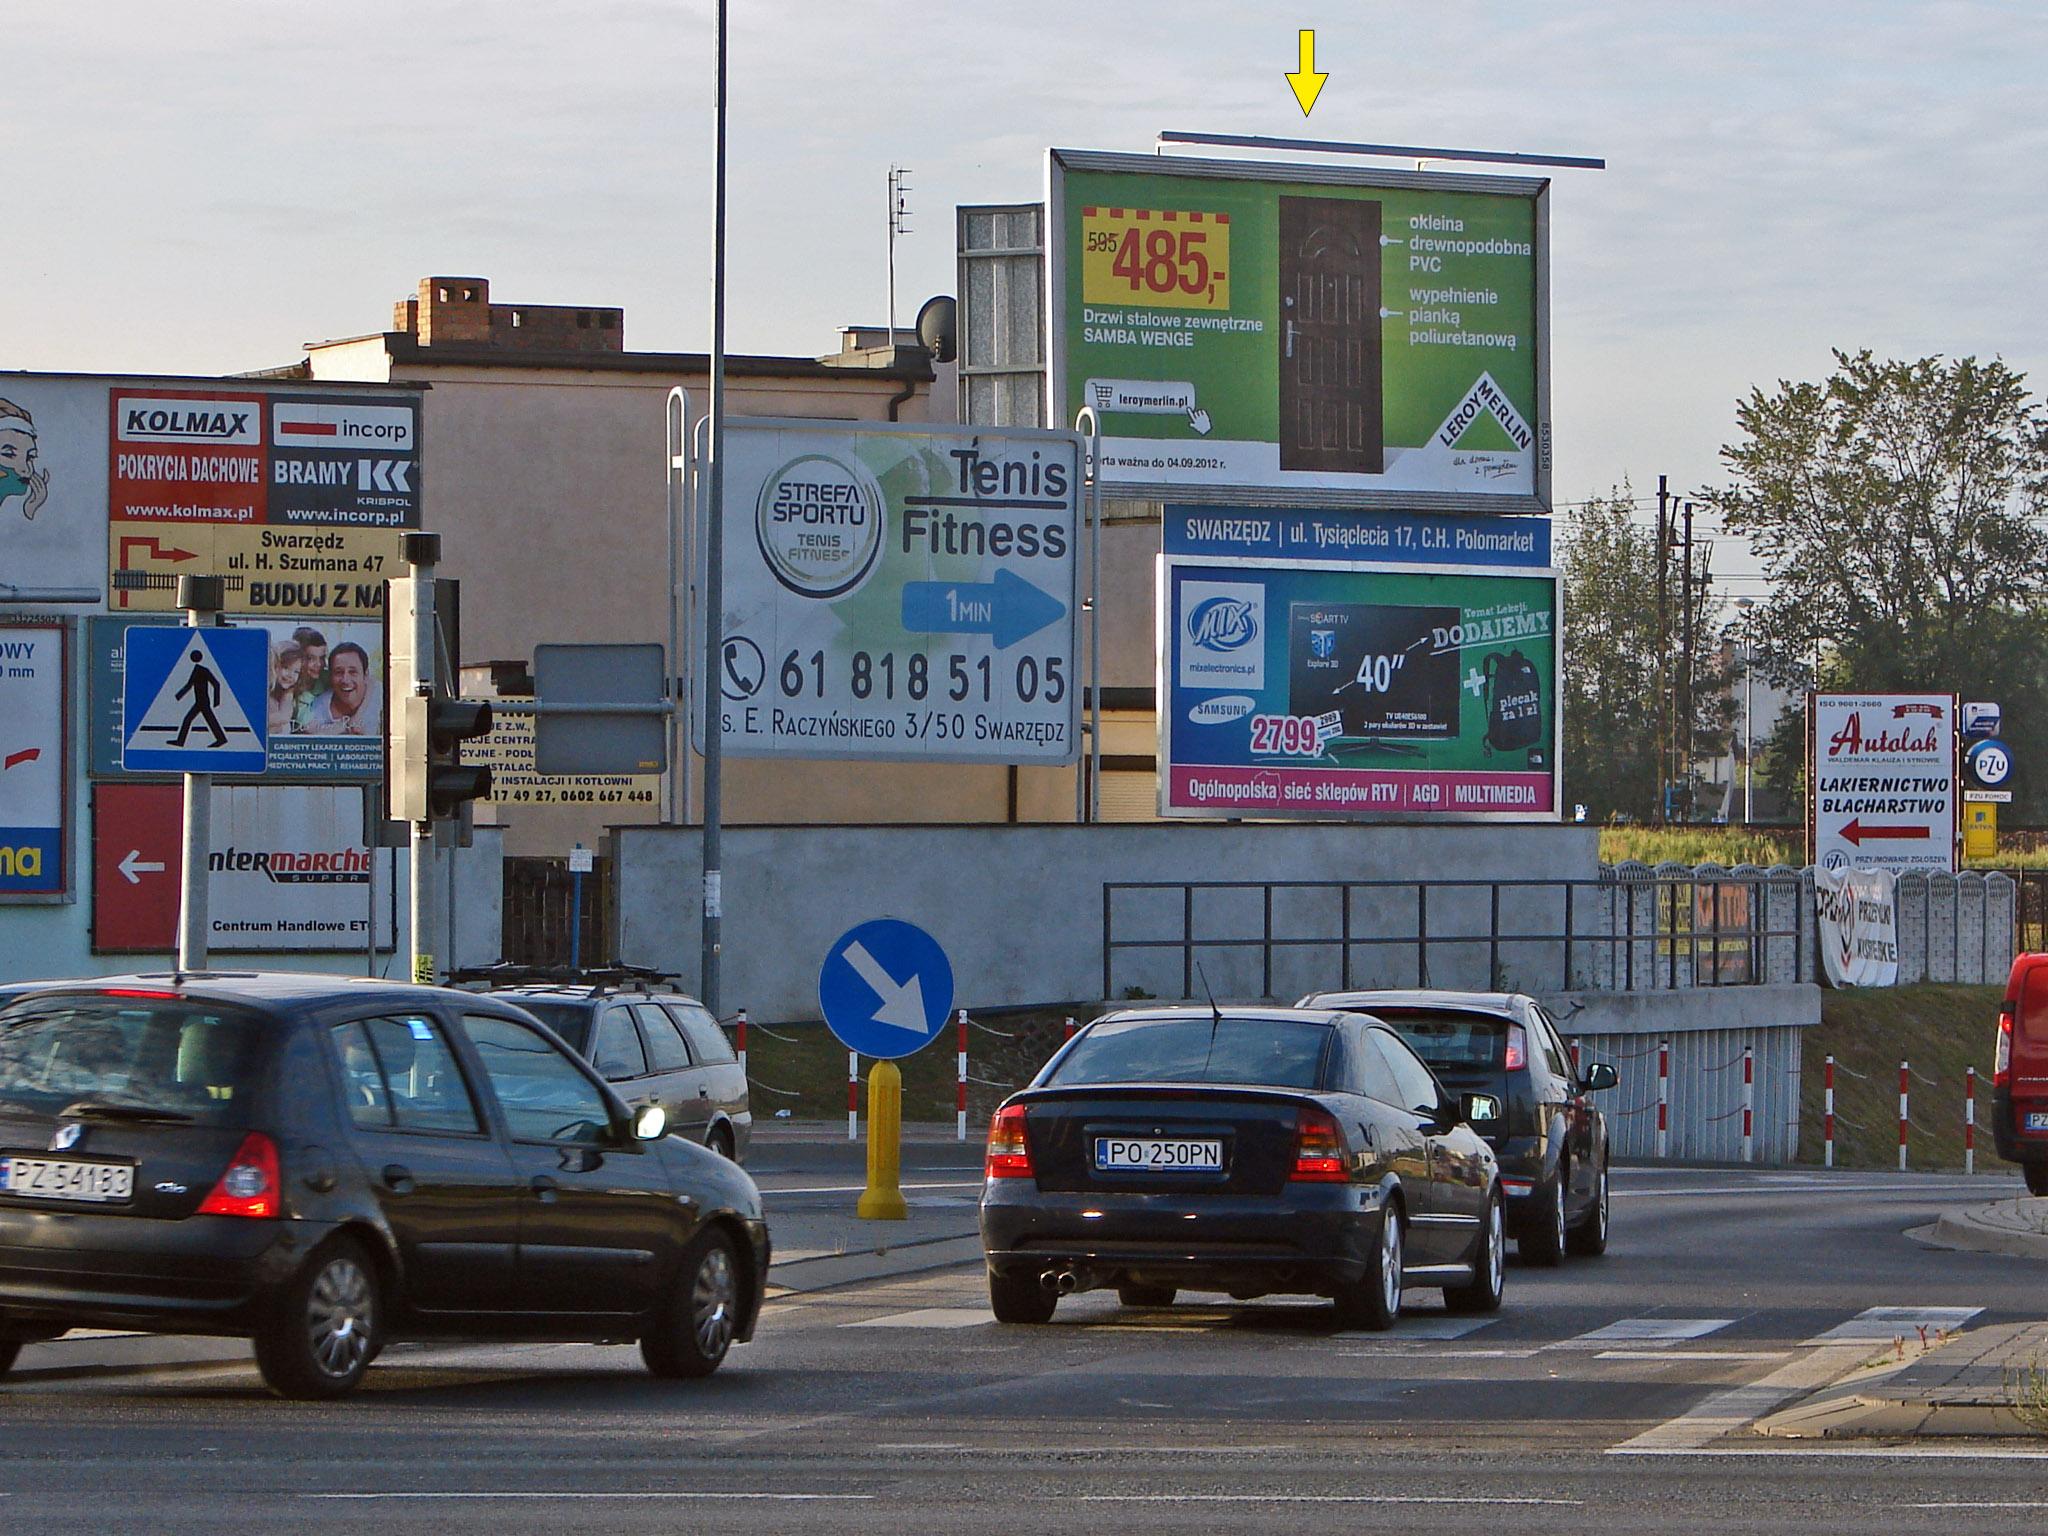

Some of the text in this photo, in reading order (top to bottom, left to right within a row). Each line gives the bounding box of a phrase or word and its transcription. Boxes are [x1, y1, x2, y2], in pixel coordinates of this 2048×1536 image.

[1409, 213, 1464, 233] okleina
[1409, 234, 1532, 256] drewnopodobna
[1409, 255, 1442, 273] PVC
[1409, 286, 1499, 305] wypełnienie
[1084, 308, 1263, 333] Drzwi stalowe zewnętrzne
[1409, 306, 1461, 328] pianką
[1084, 327, 1194, 347] SAMBA WENGE
[1409, 328, 1517, 352] poliuretanową
[1119, 393, 1189, 408] leroymerlin.pl
[126, 409, 249, 437] KOLMAX
[1440, 379, 1532, 450] LEROY MERLIN
[343, 419, 407, 442] incorp
[118, 453, 259, 484] POKRYCIA DACHOWE
[274, 459, 352, 485] BRAMY
[1086, 455, 1116, 466] Orta
[1119, 456, 1149, 468] ważna
[1152, 457, 1165, 468] do
[1167, 457, 1218, 469] 04.09.2012
[950, 450, 1067, 497] Tenis
[356, 496, 412, 507] KRISPOL
[779, 482, 859, 504] STREFA
[125, 503, 254, 521] www.kolmax.pl
[286, 508, 405, 525] www.incorp.pl
[773, 502, 865, 526] SPORTU
[261, 530, 345, 552] Swarzędz
[797, 533, 841, 548] TENIS
[902, 510, 1066, 558] Fitness
[1186, 518, 1534, 552] SWARZĘDZ ul. Tysiąclecia 17, C.H. Polomarket
[229, 553, 384, 572] ul. H. Szumana 47
[249, 580, 327, 607] BUDUJ
[332, 583, 350, 608] Z
[1464, 607, 1493, 618] Temat
[1193, 601, 1253, 647] MIX
[1432, 610, 1550, 649] DODAJEMY
[8, 667, 35, 678] mm
[780, 649, 1065, 703] 61 818 51 05
[1189, 662, 1256, 676] mixelectronics.pl
[1197, 704, 1248, 716] SAMSUNG
[1500, 690, 1538, 712] plecak
[745, 707, 763, 733] E.
[905, 711, 965, 740] 3/50
[1828, 711, 1938, 756] Autolak
[460, 735, 491, 745] ACJE
[460, 749, 496, 758] CYJNE
[489, 763, 536, 772] STALAC
[1979, 756, 2005, 775] PZU
[501, 777, 565, 785] INSTALACJI
[575, 777, 633, 785] KOTŁOWNI
[1189, 778, 1537, 805] Ogólnopolska sieć sklepów RTV AGD MULTIMEDIA
[1820, 777, 1949, 793] LAKIERNICTWO
[513, 790, 530, 801] 49
[535, 790, 556, 803] 27,
[561, 791, 594, 802] 0602
[599, 791, 623, 802] 667
[628, 791, 653, 802] 448
[1822, 799, 1945, 813] BLACHARSTWO
[208, 847, 371, 883] ntermarché
[212, 920, 371, 932] Centrum Handlowe ET
[1111, 1143, 1217, 1164] PO 250PN
[15, 1162, 46, 1187] PZ
